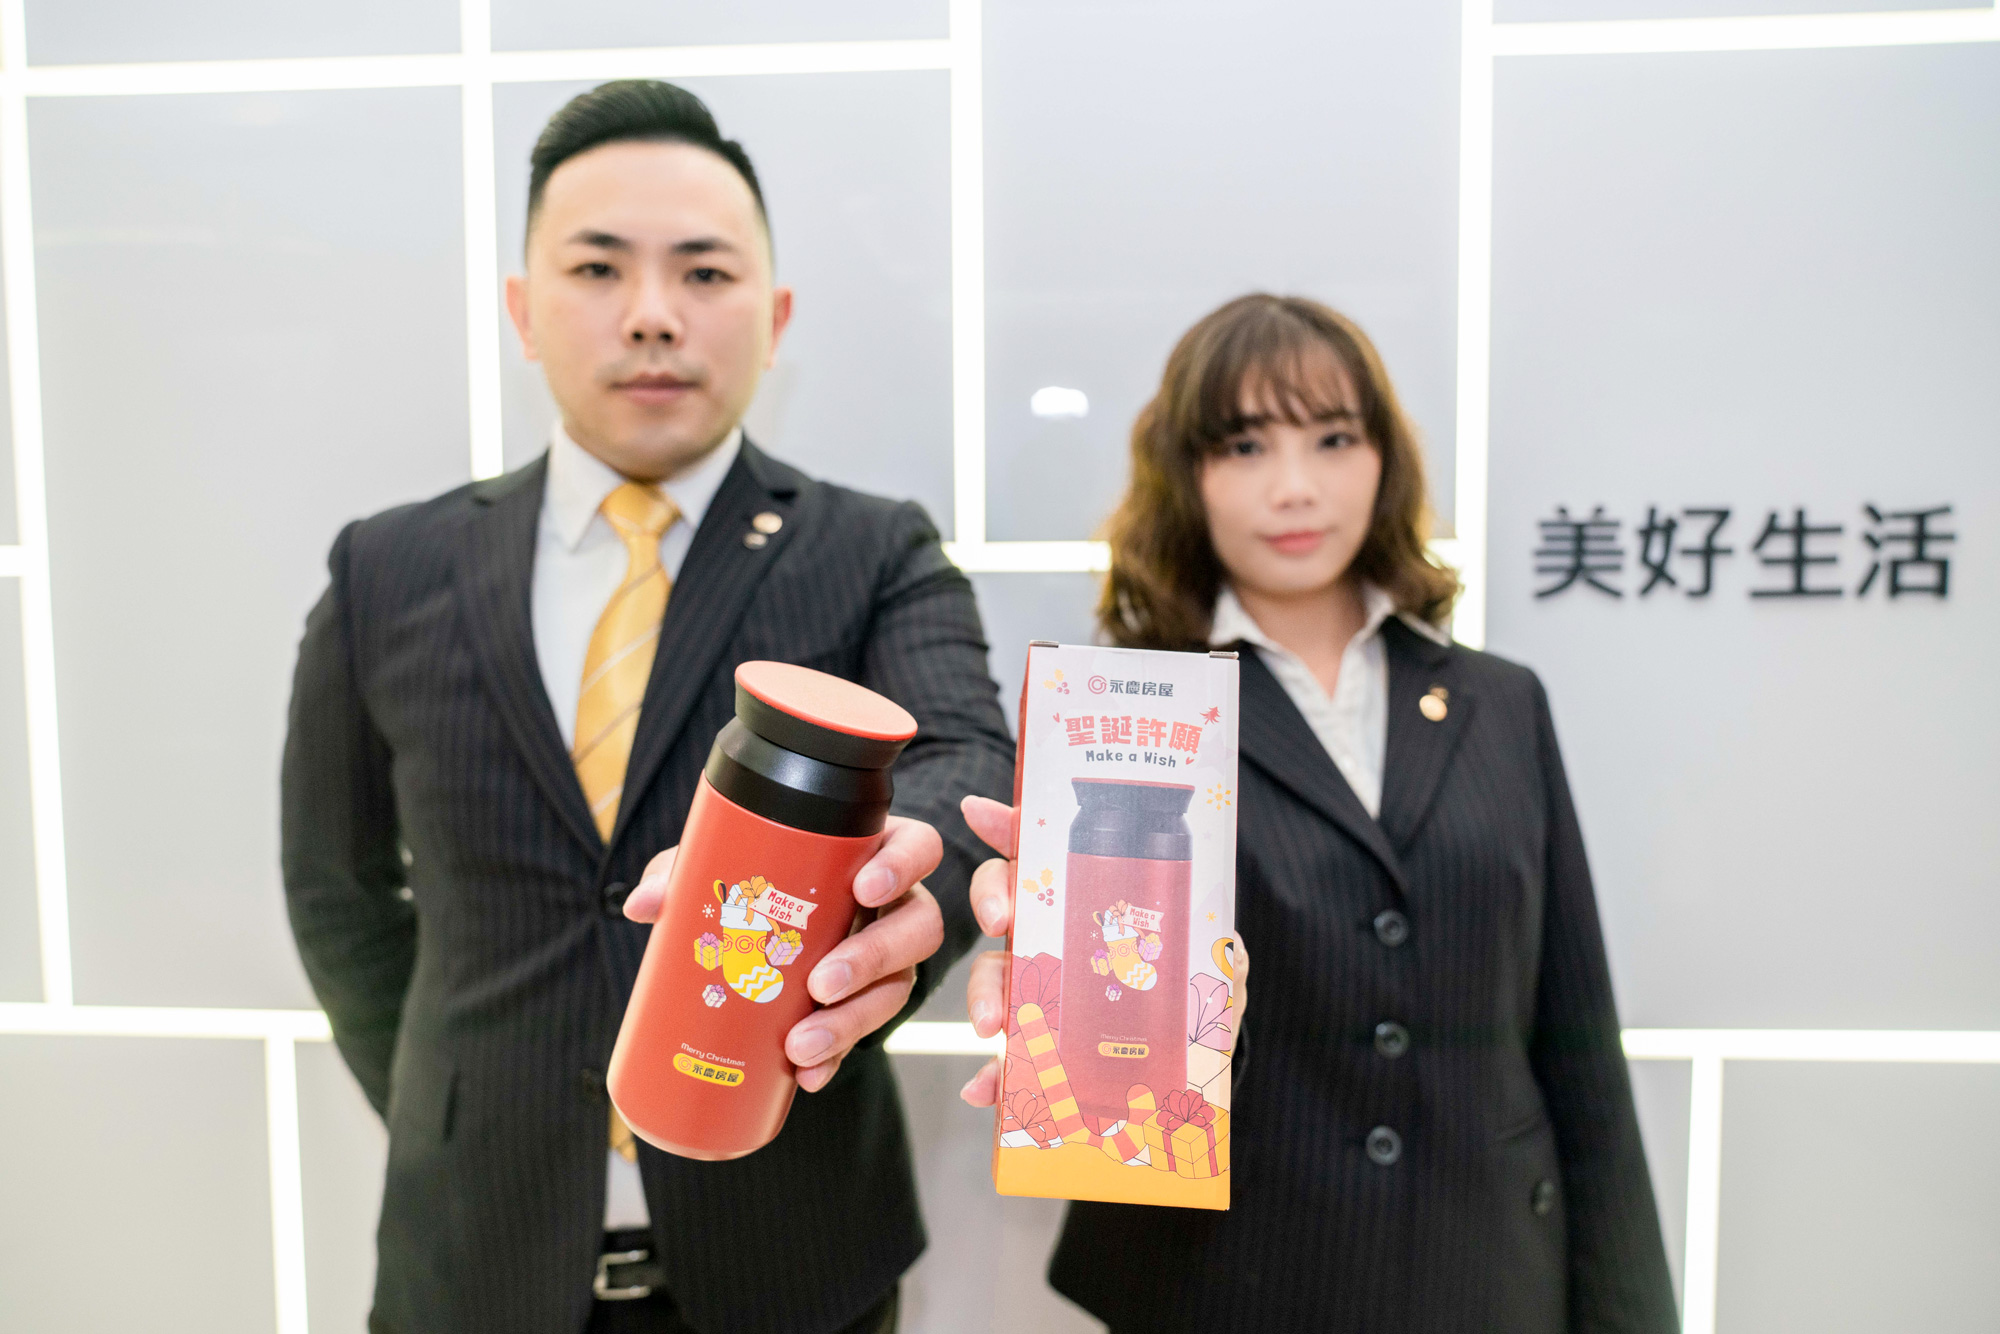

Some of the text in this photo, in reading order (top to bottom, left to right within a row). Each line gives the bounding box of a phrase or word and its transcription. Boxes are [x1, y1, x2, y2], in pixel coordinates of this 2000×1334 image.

[1533, 504, 1956, 599] 美好生活
[1109, 679, 1174, 697] 永慶房屋
[1064, 715, 1203, 754] 聖誕許願
[1085, 749, 1177, 768] Make a Wish
[767, 890, 804, 913] Make a
[768, 903, 792, 922] Wish
[1129, 907, 1149, 919] Make
[1132, 918, 1150, 928] Wish
[1100, 1033, 1119, 1042] Merry
[681, 1042, 746, 1067] Merry Christmas
[692, 1063, 740, 1083] 永慶房屋
